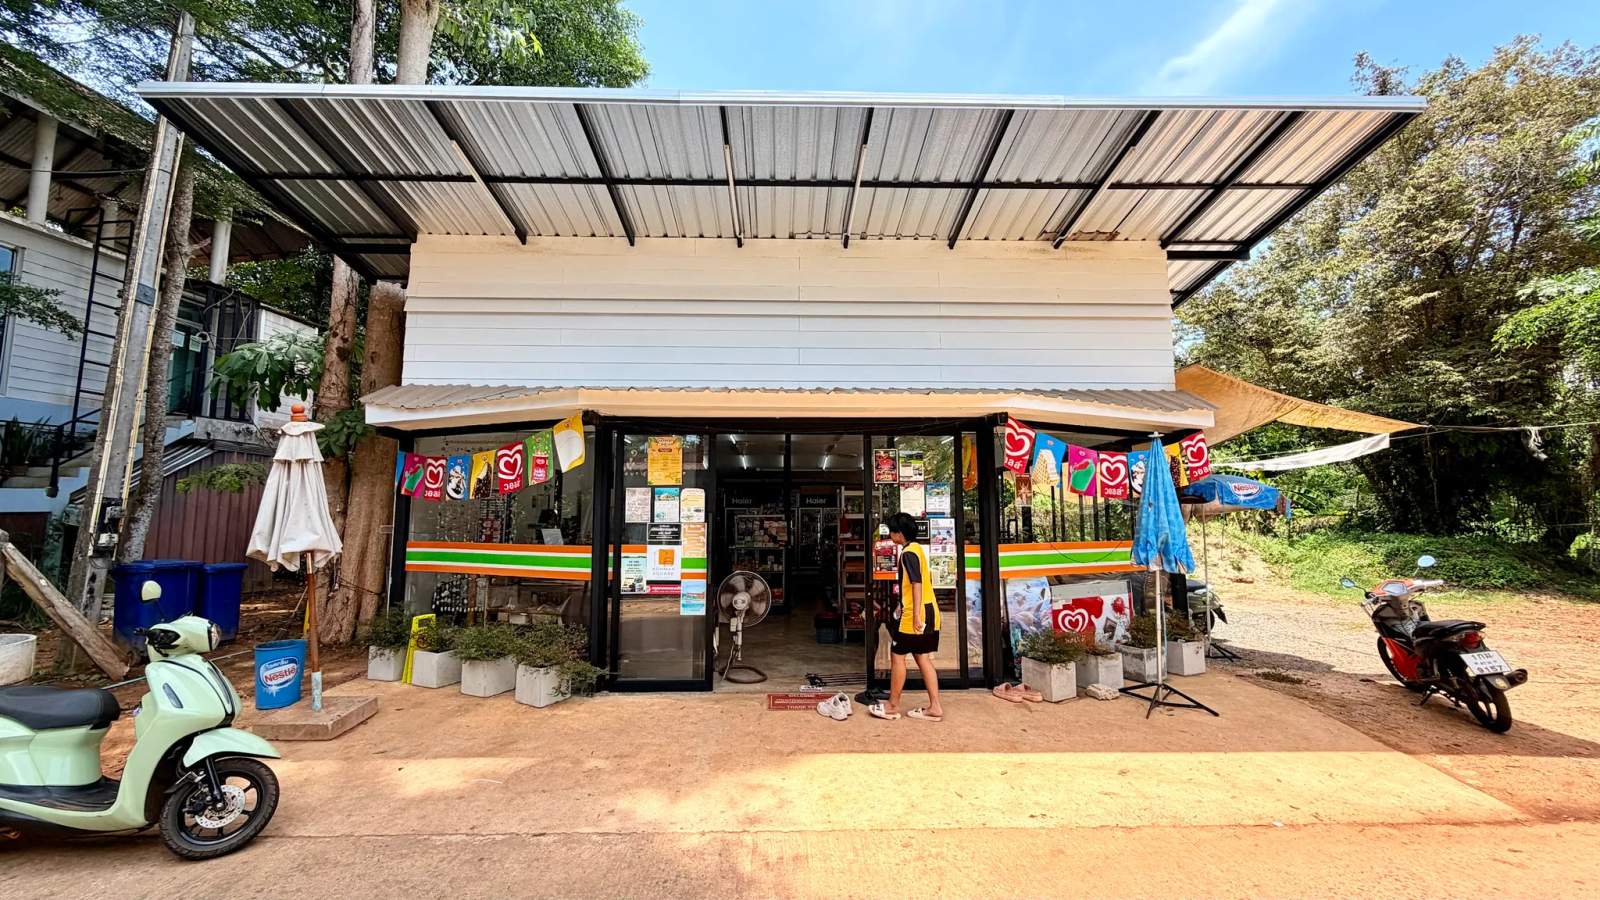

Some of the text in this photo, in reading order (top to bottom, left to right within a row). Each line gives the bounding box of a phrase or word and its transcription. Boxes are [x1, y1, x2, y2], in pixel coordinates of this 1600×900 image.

[732, 496, 753, 505] Haier
[805, 496, 827, 505] Haier
[1477, 665, 1503, 673] 9157
